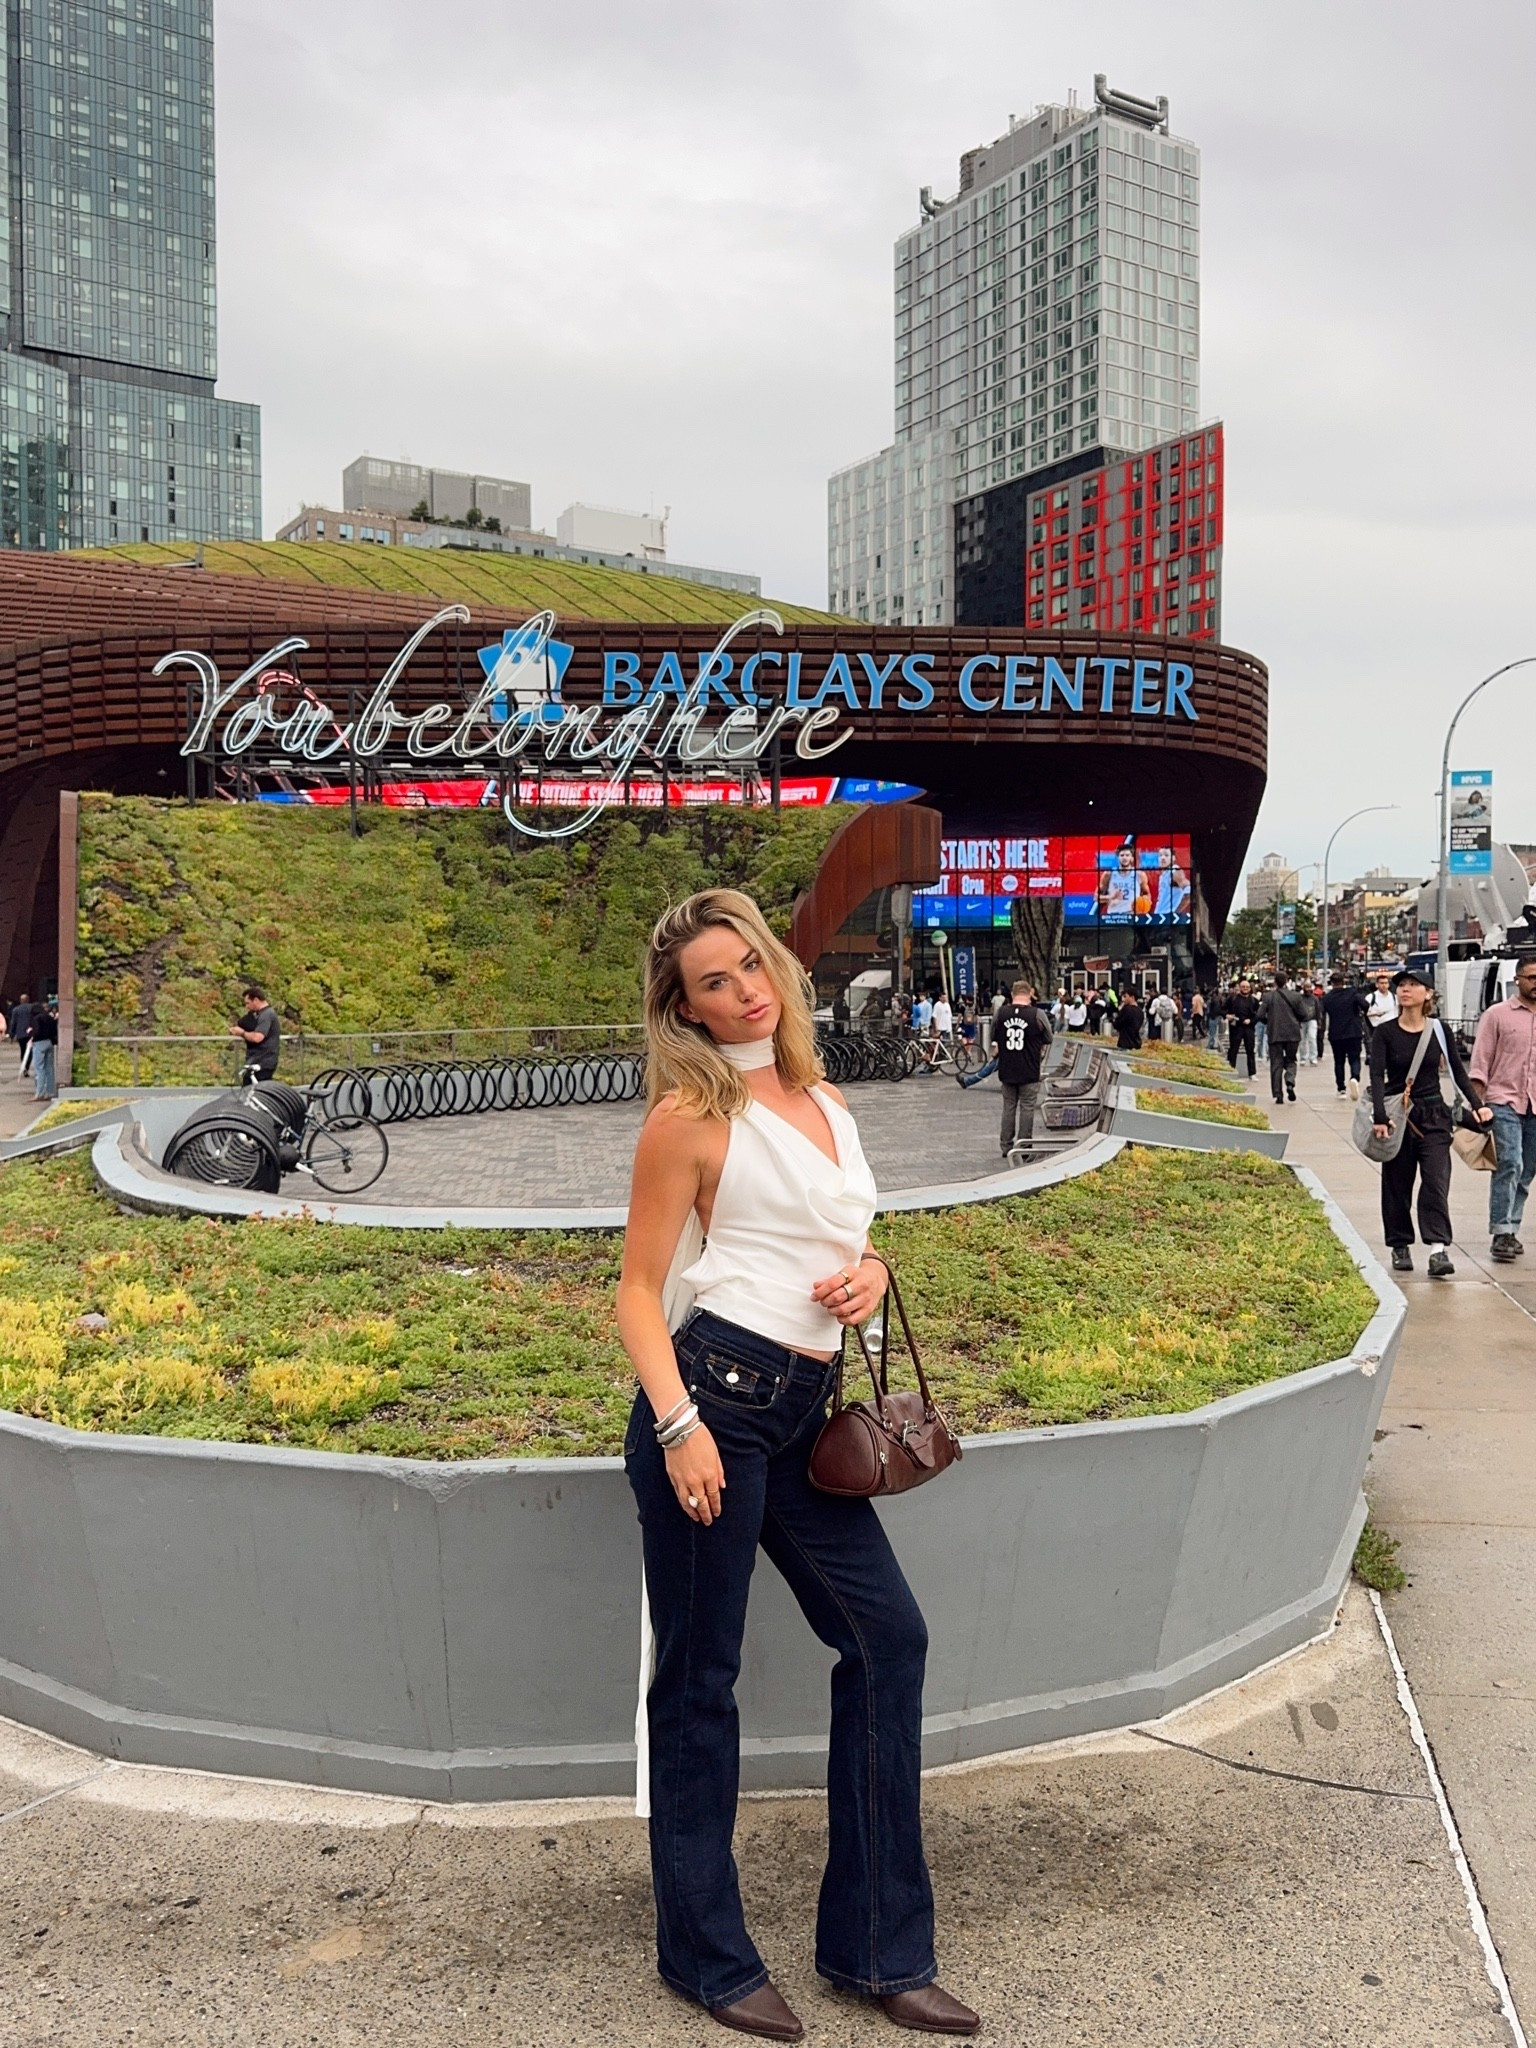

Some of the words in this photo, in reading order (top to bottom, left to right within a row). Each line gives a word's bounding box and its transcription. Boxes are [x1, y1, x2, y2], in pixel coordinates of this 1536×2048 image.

[603, 651, 935, 711] BARCLAYS
[958, 653, 1199, 721] CENTER
[152, 637, 354, 760] You
[354, 604, 666, 838] belong
[660, 609, 855, 761] here
[1461, 776, 1482, 784] NYC
[637, 787, 669, 806] HER
[780, 786, 817, 801] ESPN
[941, 840, 1001, 870] STARTS
[1005, 839, 1049, 869] HERE
[961, 875, 985, 895] 8PM
[1029, 877, 1062, 887] ESPN
[959, 968, 967, 995] CLEAR
[1006, 1027, 1025, 1051] 33
